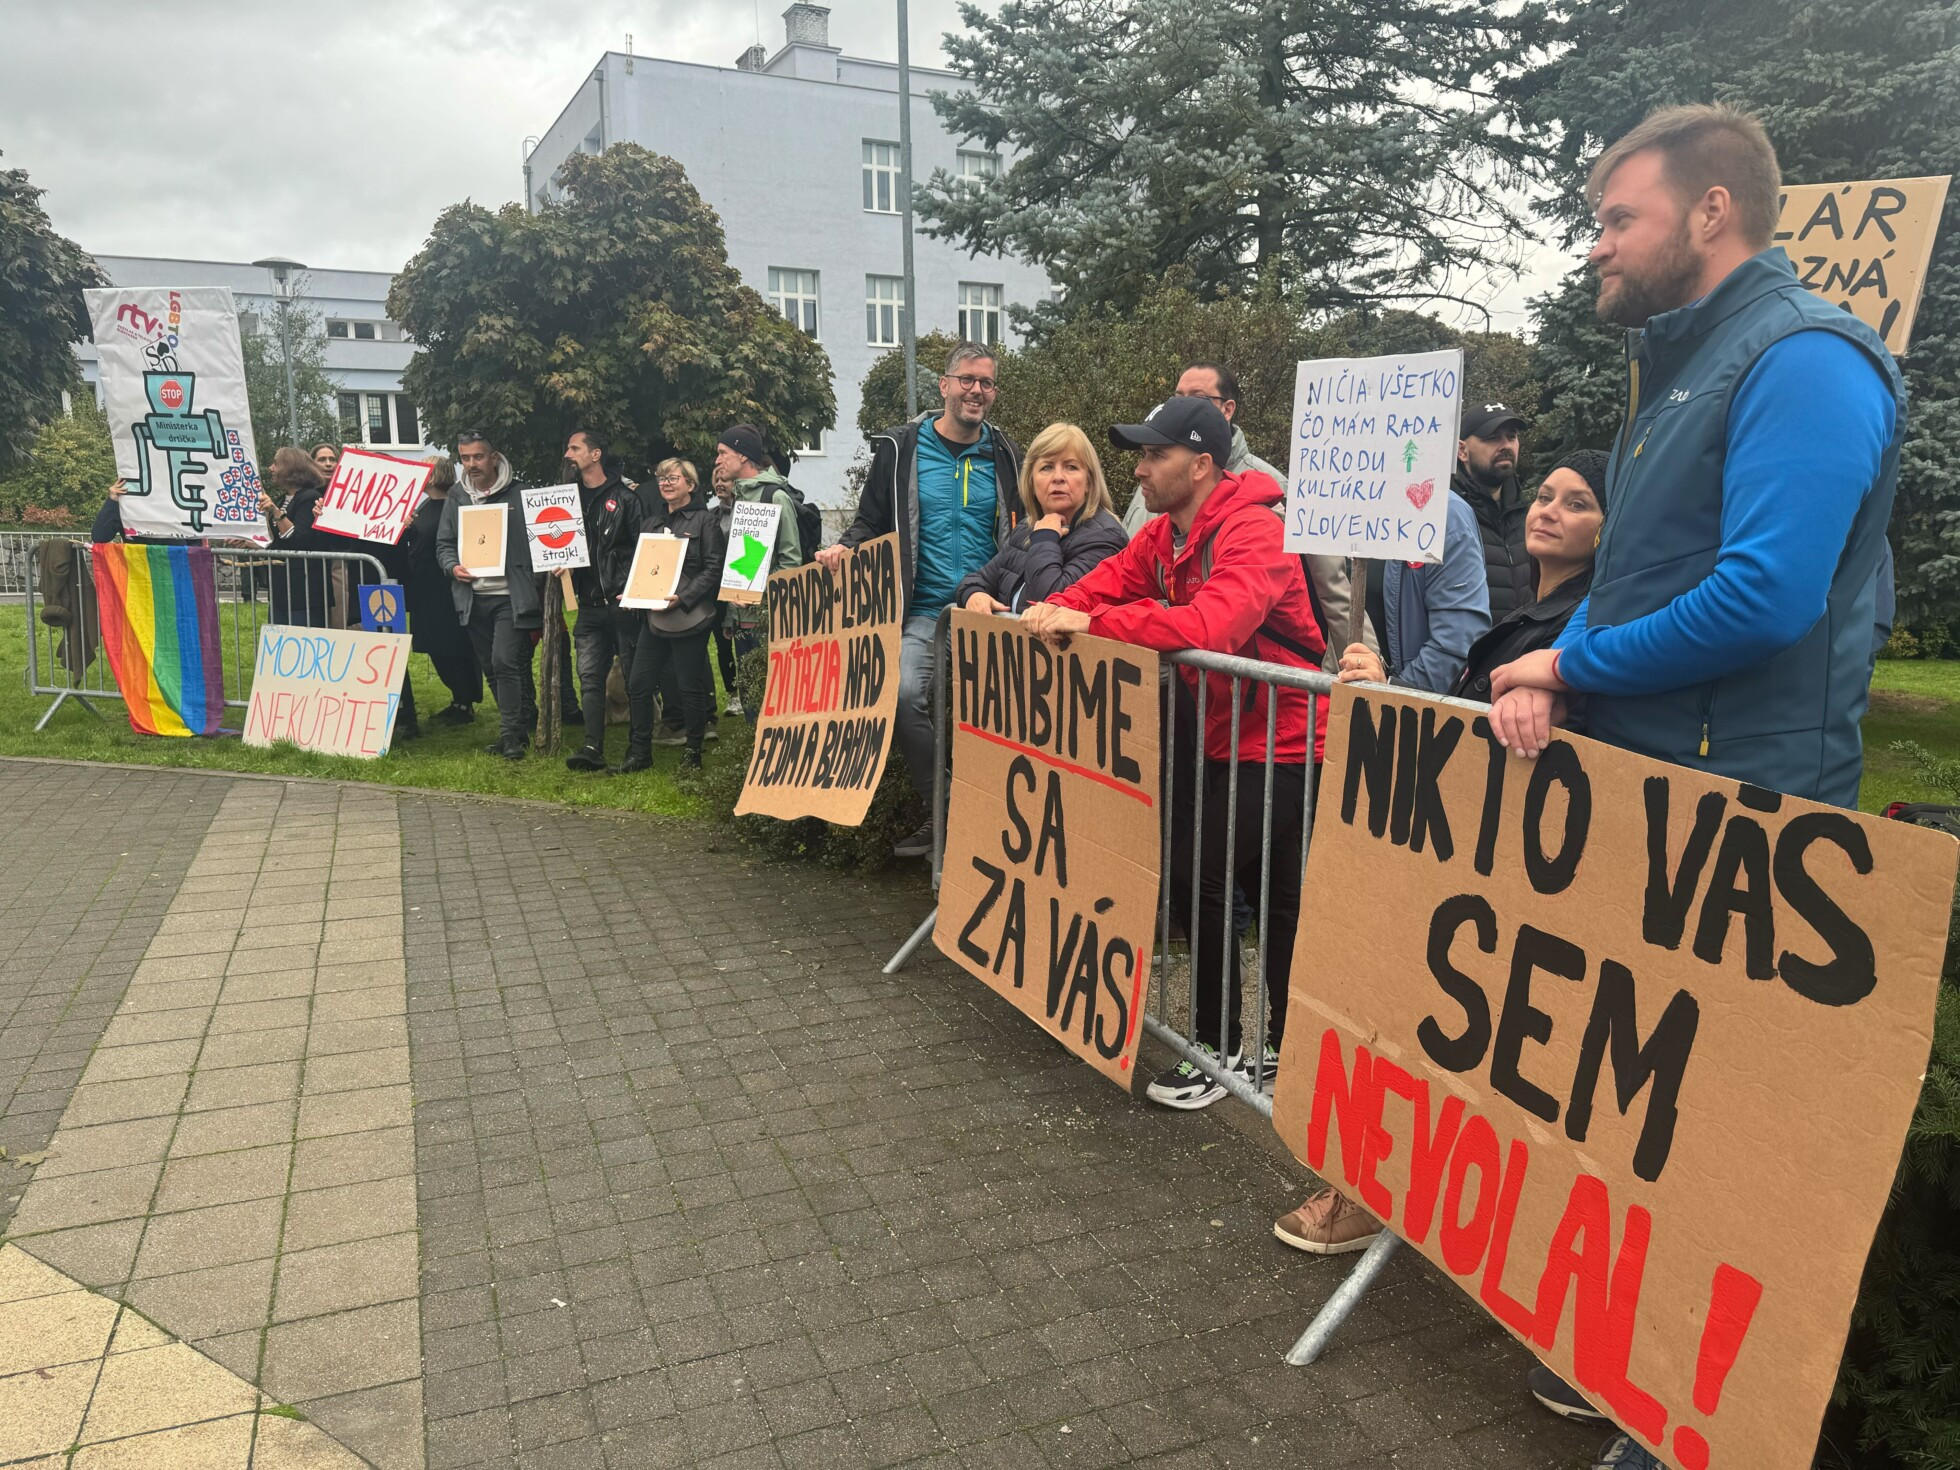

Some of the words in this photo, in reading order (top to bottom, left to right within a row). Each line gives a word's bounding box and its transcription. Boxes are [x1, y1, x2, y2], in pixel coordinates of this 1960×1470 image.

[161, 388, 182, 399] STOP
[1307, 368, 1367, 406] NIČIA
[1379, 364, 1456, 402] VŠETKO
[155, 421, 199, 431] Ministerka
[168, 434, 197, 443] drtička
[1300, 410, 1324, 439] ČO
[1332, 411, 1375, 437] MÁM
[1386, 413, 1442, 438] RADA
[1300, 438, 1385, 474] PRÍRODU
[526, 494, 576, 509] Kultúrny
[1296, 475, 1387, 501] KULTÚRU
[733, 515, 768, 528] národná
[735, 504, 776, 518] Slobodná
[1292, 507, 1437, 551] SLOVENSKO
[363, 521, 395, 541] VÁM
[731, 526, 760, 539] galéria
[542, 546, 579, 561] štrajk!
[769, 566, 834, 642] PRAVDA
[841, 540, 896, 628] LÁSKA
[260, 634, 357, 683] MODRU
[356, 644, 399, 688] SI
[843, 632, 886, 712] NAD
[957, 627, 1142, 784] HANBÍME
[749, 723, 806, 788] FICOM
[801, 721, 820, 788] A
[812, 716, 887, 790] BLAHOM
[1001, 755, 1068, 889] SA
[1340, 696, 1592, 896] NIKTO
[1641, 775, 1878, 1008] VÁS
[957, 856, 1026, 989] ZA
[1046, 896, 1144, 1071] VÁS!
[1416, 893, 1700, 1183] SEM
